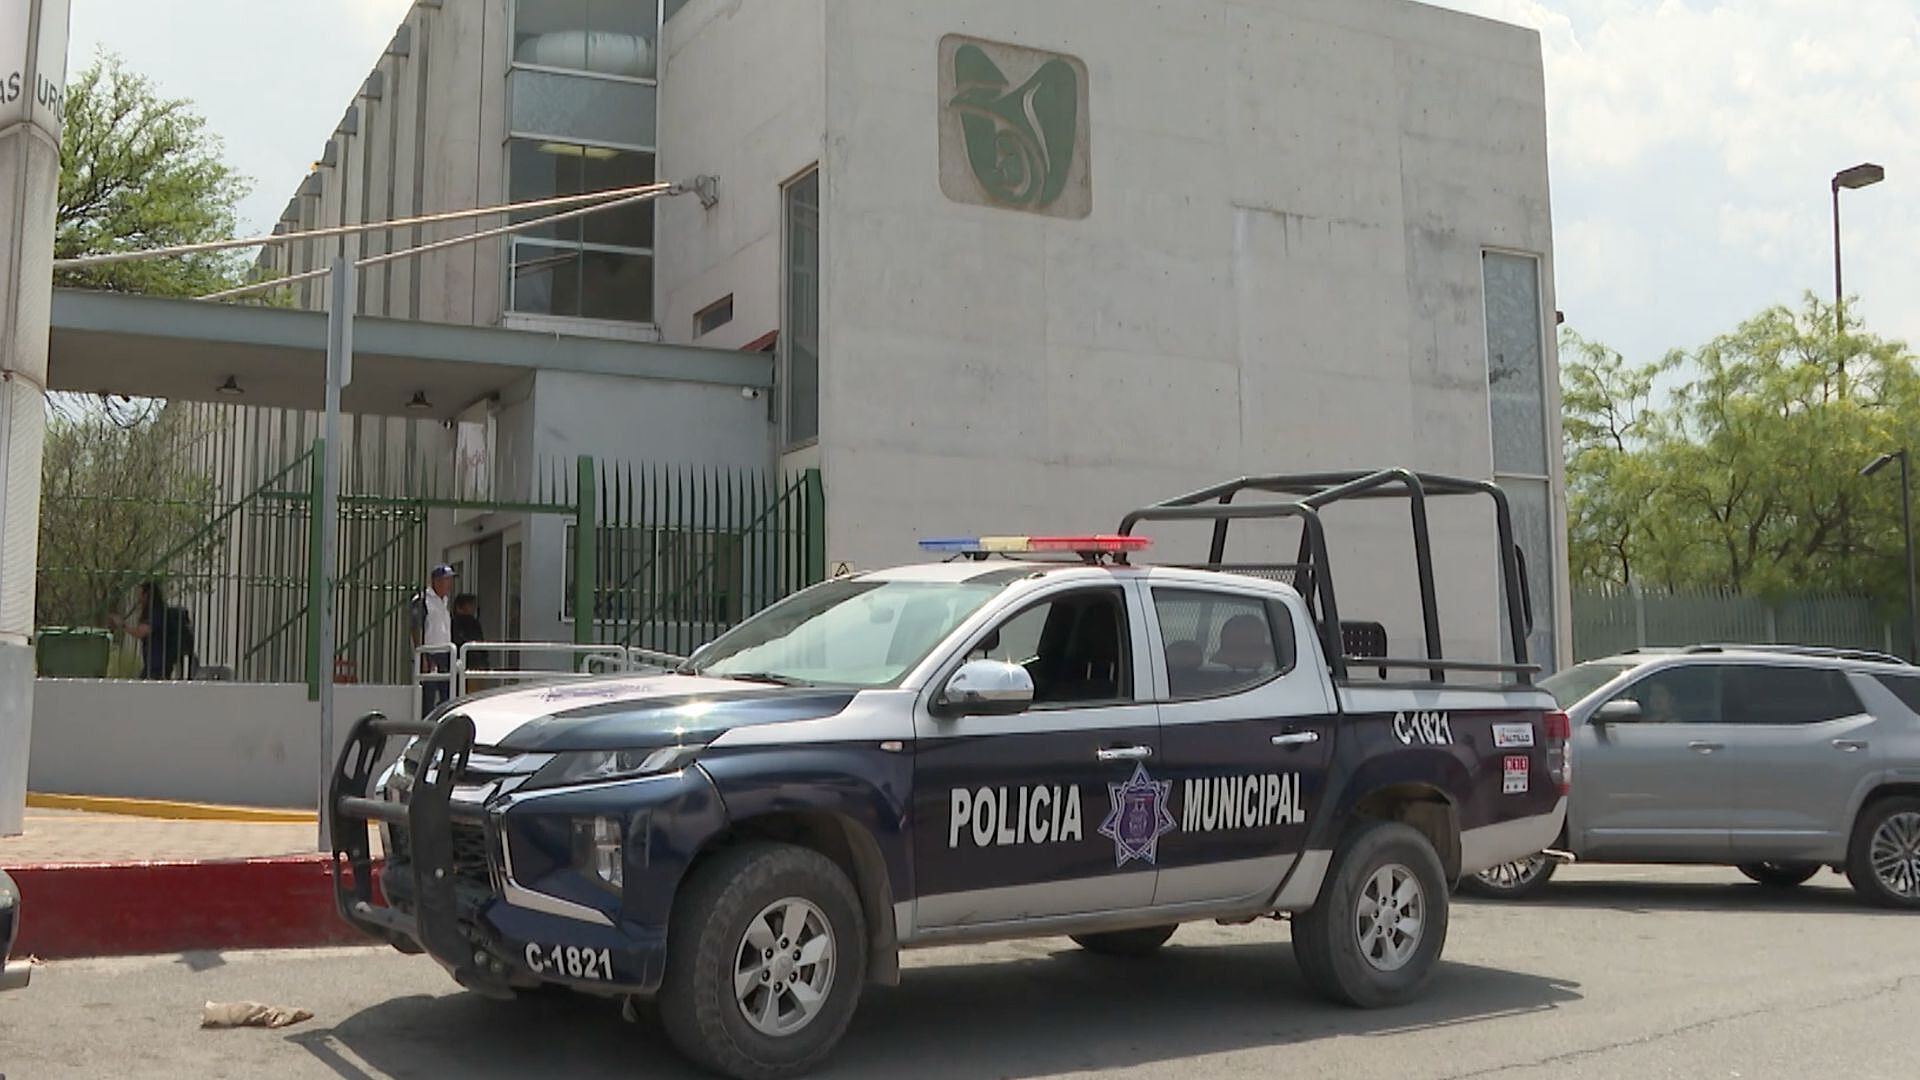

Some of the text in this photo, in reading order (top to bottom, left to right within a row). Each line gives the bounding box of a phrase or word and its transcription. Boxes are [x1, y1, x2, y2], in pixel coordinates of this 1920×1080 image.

[1394, 711, 1454, 745] C-1821
[949, 772, 1305, 848] POLICIA MUNICIPAL
[525, 941, 613, 980] C-1821
